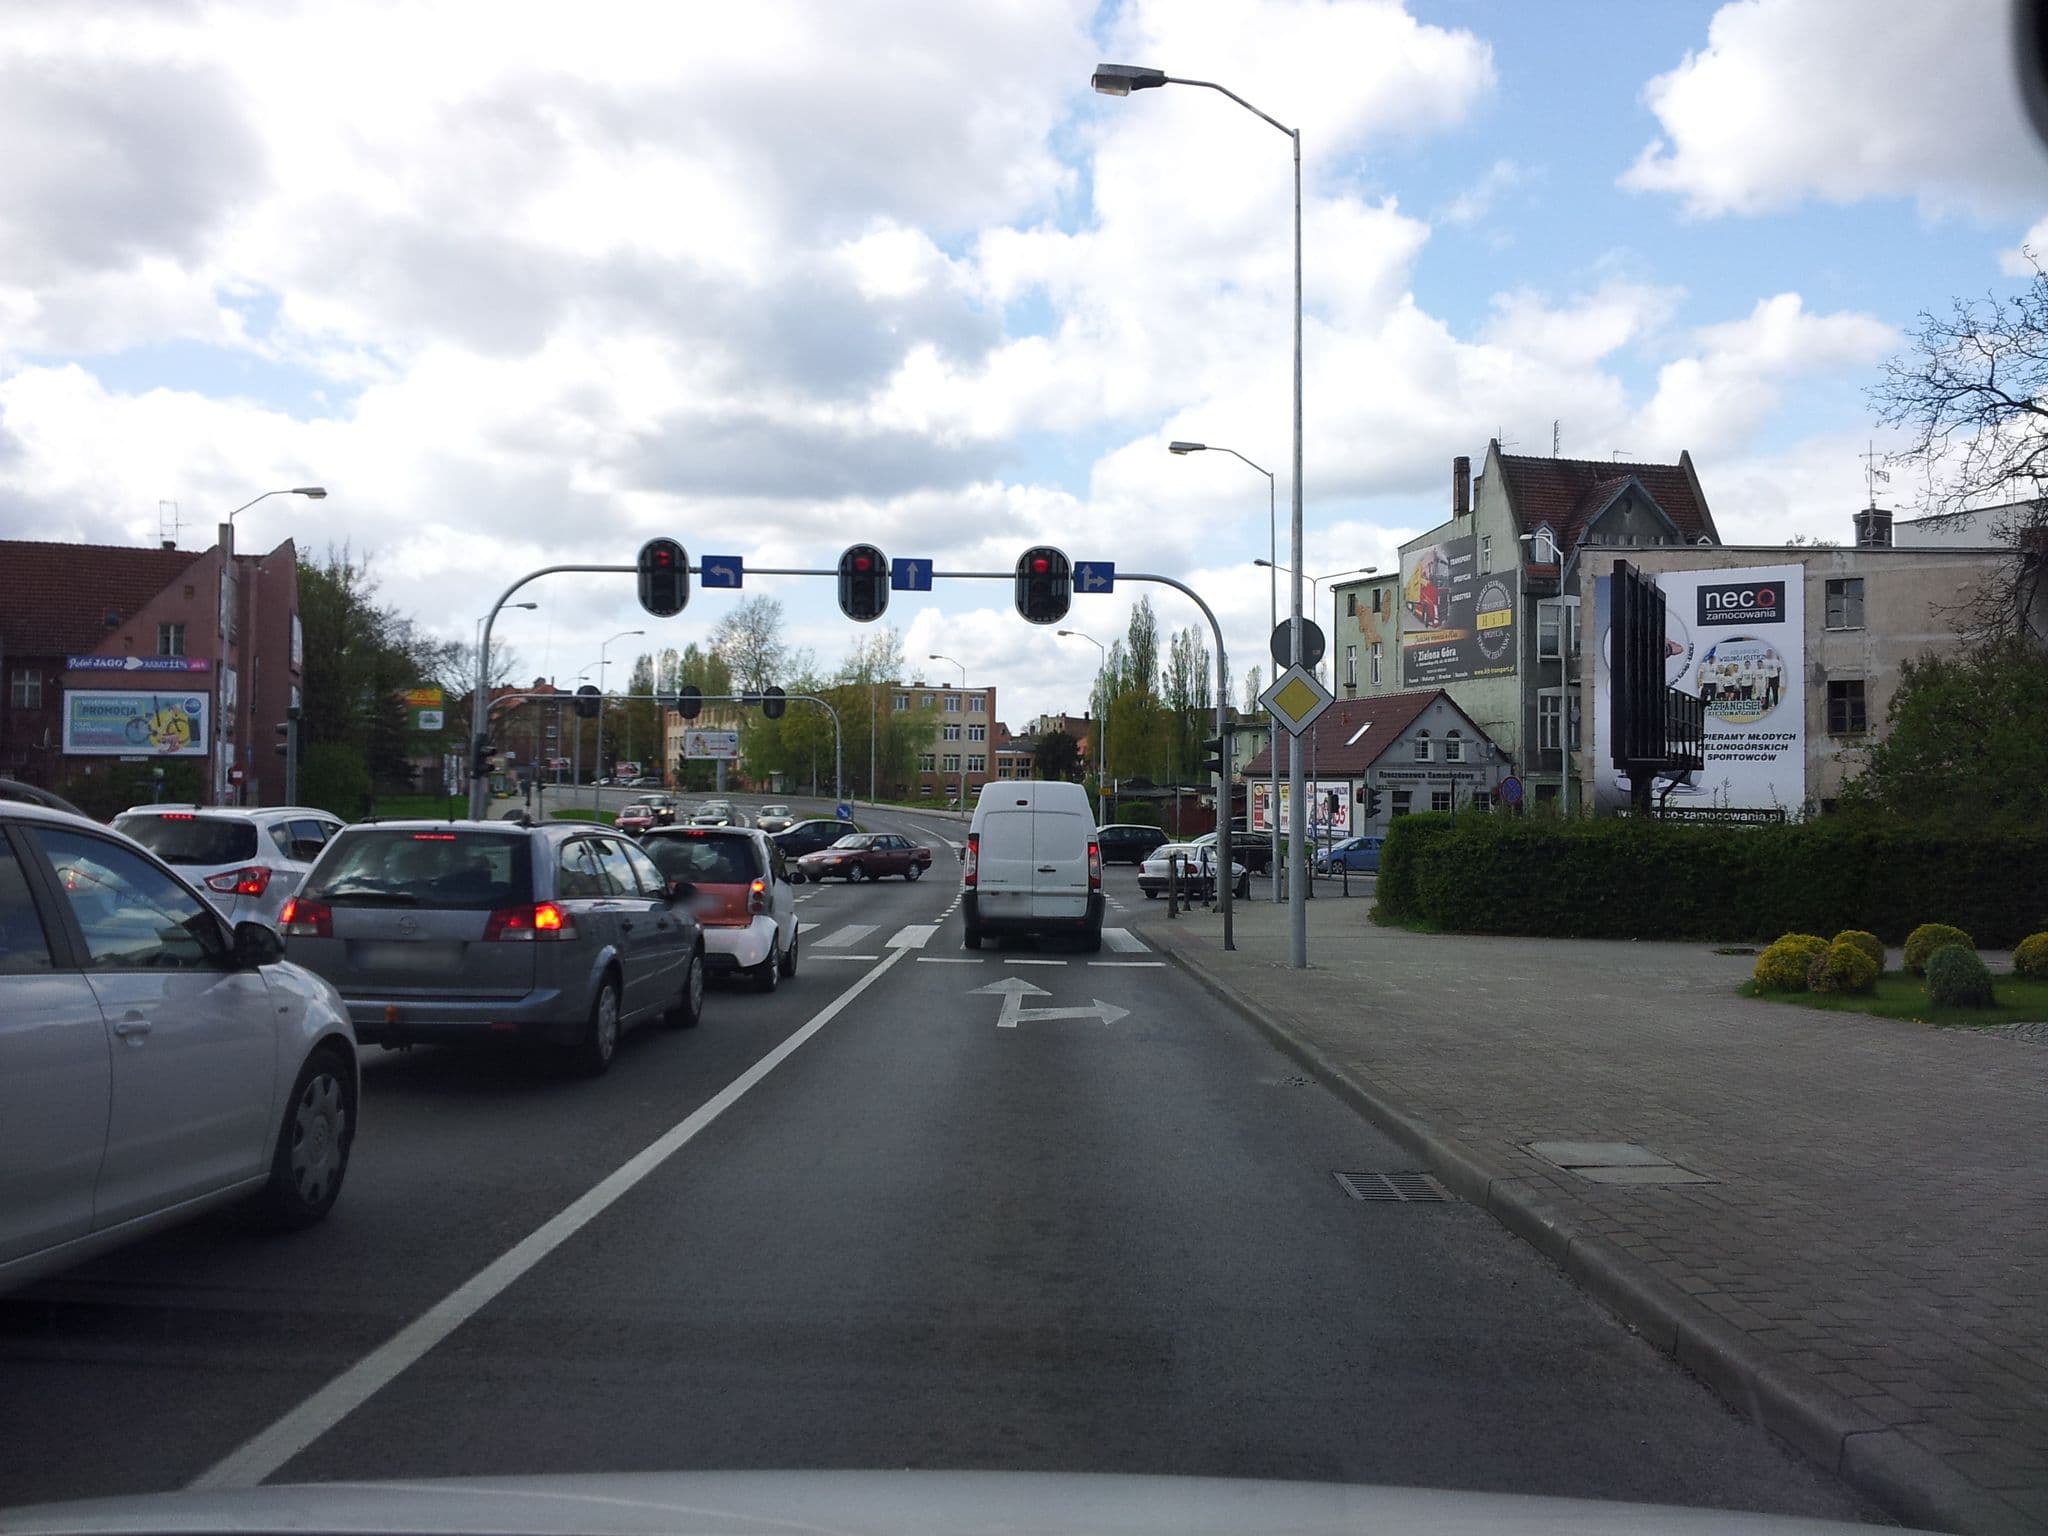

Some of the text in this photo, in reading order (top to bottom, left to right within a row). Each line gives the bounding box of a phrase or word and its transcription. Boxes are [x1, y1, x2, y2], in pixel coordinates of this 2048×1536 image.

[1705, 588, 1776, 608] neco
[1706, 609, 1776, 620] zamocowania
[1418, 646, 1457, 661] Zielona Góra
[82, 706, 137, 716] PROMOCJA
[1702, 733, 1797, 741] PIERAMY MŁODYCH
[1698, 742, 1789, 751] ELONOGÓRSKICH
[1707, 752, 1777, 761] SPORTOWCÓW
